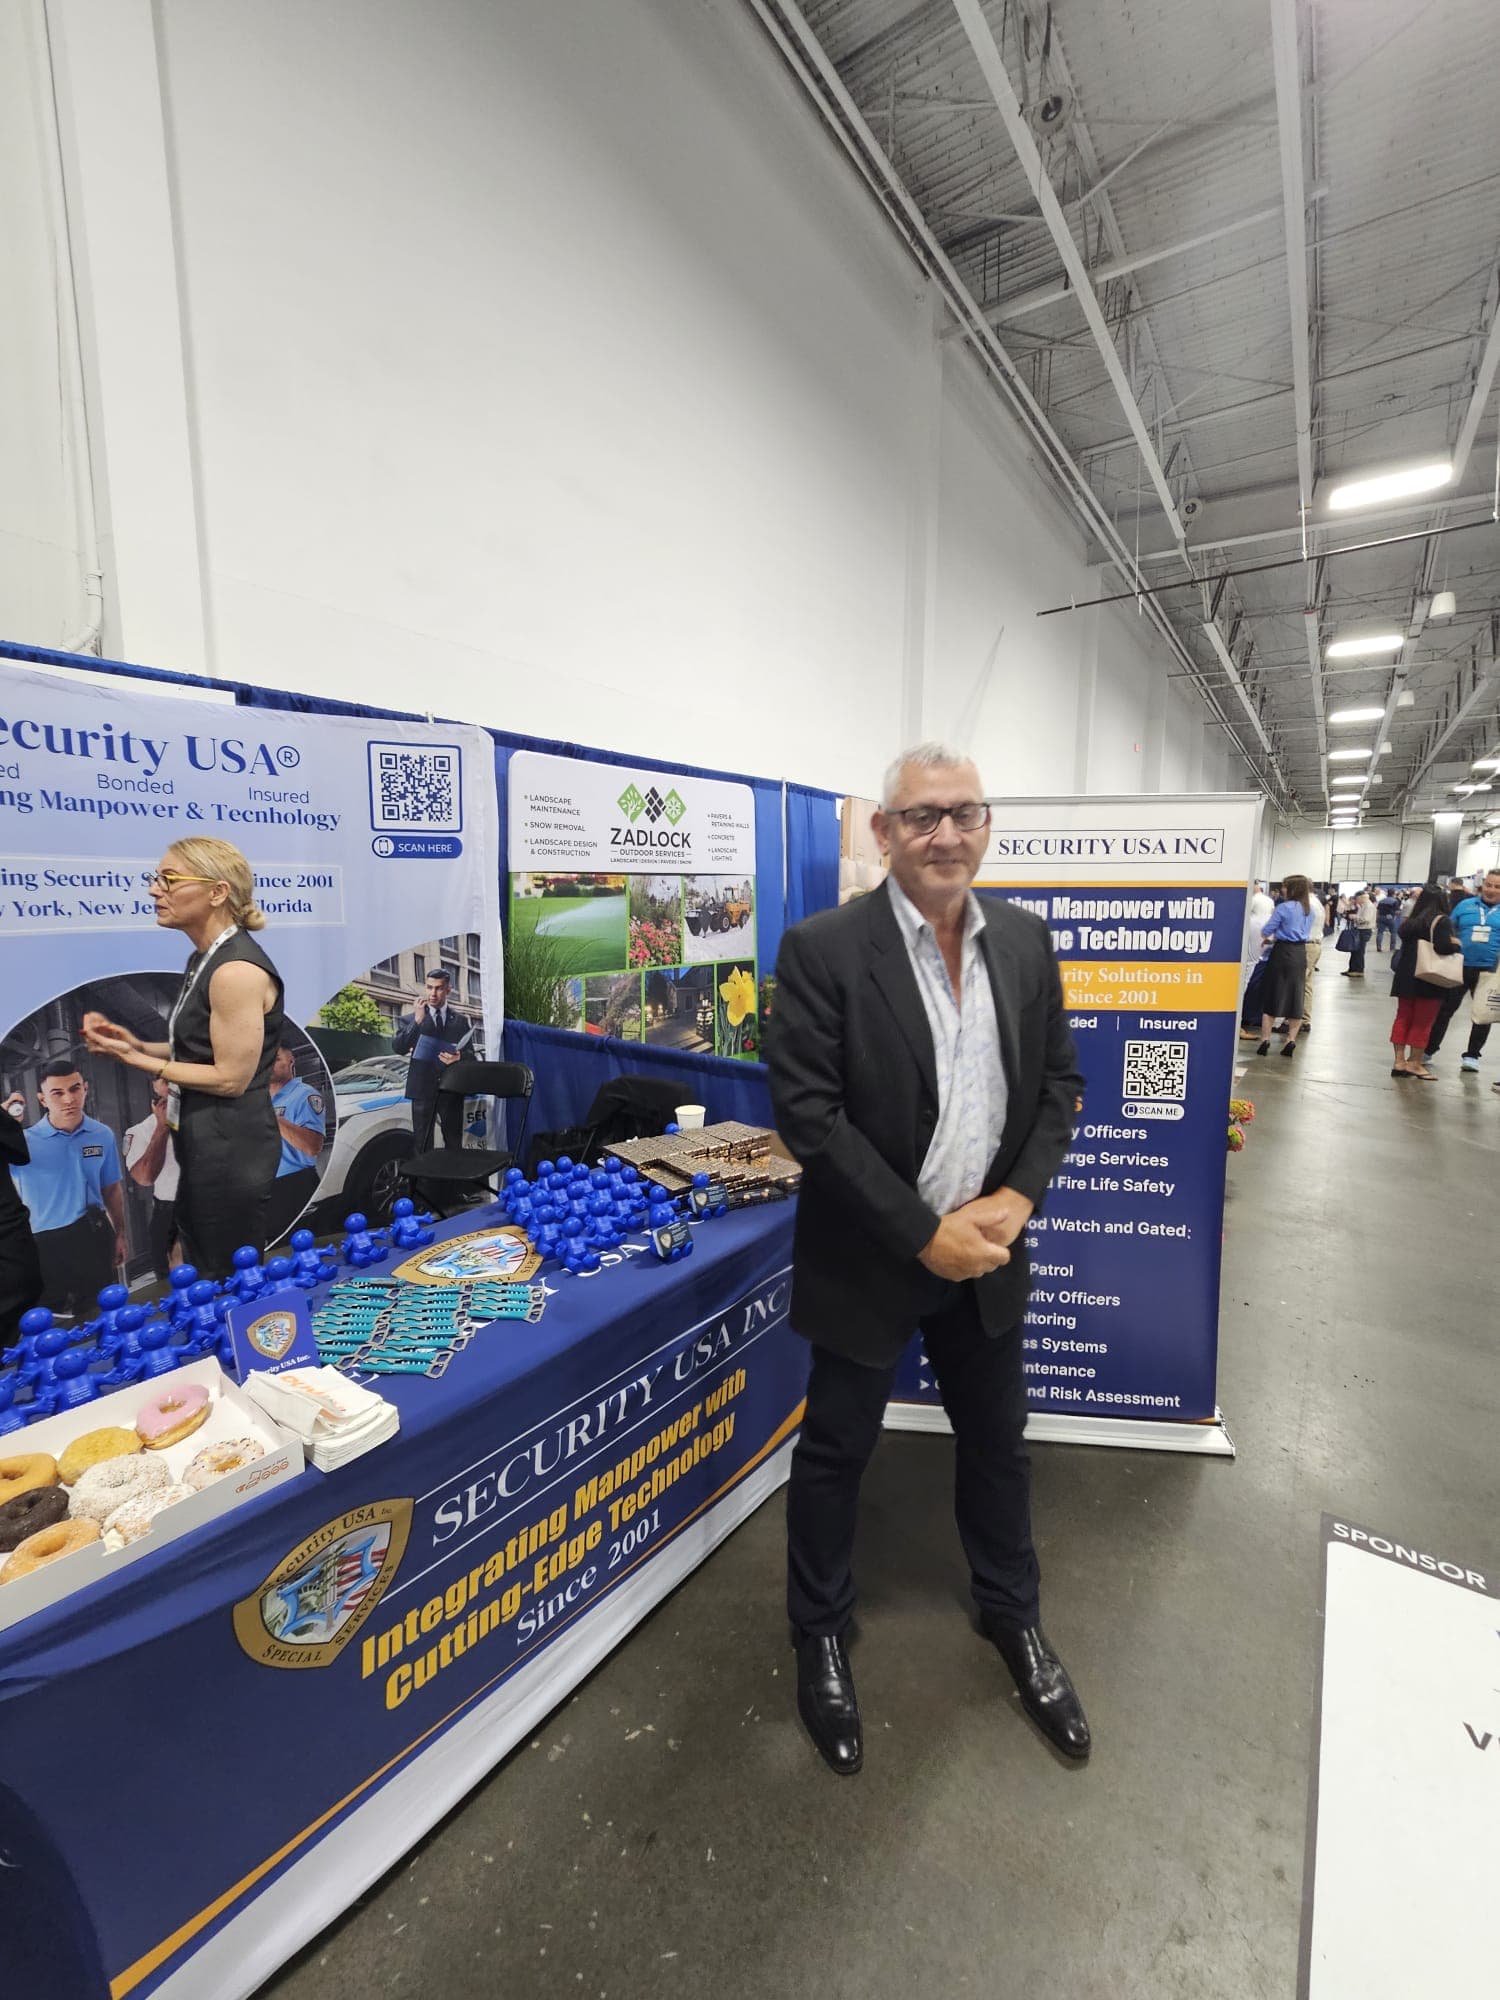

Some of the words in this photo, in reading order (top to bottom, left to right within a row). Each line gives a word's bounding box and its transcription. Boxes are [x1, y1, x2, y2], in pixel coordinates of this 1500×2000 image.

[97, 774, 174, 794] Bonded
[249, 787, 310, 803] Insured
[529, 794, 572, 805] LANDSCAPE
[40, 789, 179, 819] Manpower
[186, 802, 204, 819] &
[211, 803, 341, 831] Tecnhology
[530, 805, 581, 816] MAINTENANCE
[530, 821, 552, 829] SNOW
[554, 823, 586, 832] REMOVAL
[530, 838, 572, 847] LANDSCAPE
[573, 840, 598, 848] DESIGN
[610, 828, 692, 848] ZADLOCK
[998, 838, 1116, 856] SECURITY
[1123, 838, 1167, 855] USA
[1175, 837, 1217, 855] INC
[398, 843, 425, 852] SCAN
[427, 844, 453, 853] HERE
[537, 848, 591, 857] CONSTRUCTION
[619, 848, 654, 857] OUTDOOR
[655, 850, 685, 858] SERVICES
[44, 869, 134, 892] Security
[254, 873, 292, 888] ince
[297, 874, 334, 888] 2001
[12, 900, 72, 918] York,
[78, 900, 125, 916] New
[255, 899, 312, 913] lorida
[1052, 896, 1165, 921] Manpower
[1167, 896, 1215, 919] with
[1078, 926, 1213, 953] Technology
[1098, 967, 1181, 984] Solutions
[1185, 968, 1203, 984] in
[1067, 989, 1113, 1004] Since
[1118, 990, 1159, 1005] 2001
[1139, 1017, 1198, 1031] Insured
[1139, 1107, 1163, 1115] SCAN
[1165, 1108, 1178, 1116] ME
[1084, 1125, 1148, 1140] Officers
[1099, 1152, 1169, 1167] Services
[1057, 1175, 1087, 1190] Fire
[1090, 1177, 1119, 1191] Life
[1122, 1178, 1176, 1196] Safety
[1051, 1218, 1101, 1233] Watch
[1104, 1220, 1134, 1234] and
[1029, 1262, 1074, 1277] Patrol
[1058, 1290, 1121, 1306] Officers
[1041, 1337, 1108, 1354] Systems
[1050, 1386, 1082, 1401] Risk
[1085, 1388, 1181, 1408] Assessment
[432, 1365, 664, 1548] SECURITY
[673, 1330, 731, 1382] USA
[741, 1281, 787, 1335] INC
[342, 1506, 375, 1530] USA
[361, 1503, 567, 1679] Integrating
[573, 1400, 702, 1520] Manpower
[705, 1367, 747, 1417] with
[385, 1520, 603, 1710] Cutting-Edge
[608, 1411, 736, 1531] Technology
[1332, 1522, 1488, 1590] SPONSOR
[517, 1564, 598, 1646] Since
[607, 1508, 662, 1571] 2001
[262, 1643, 323, 1663] SPECIAL
